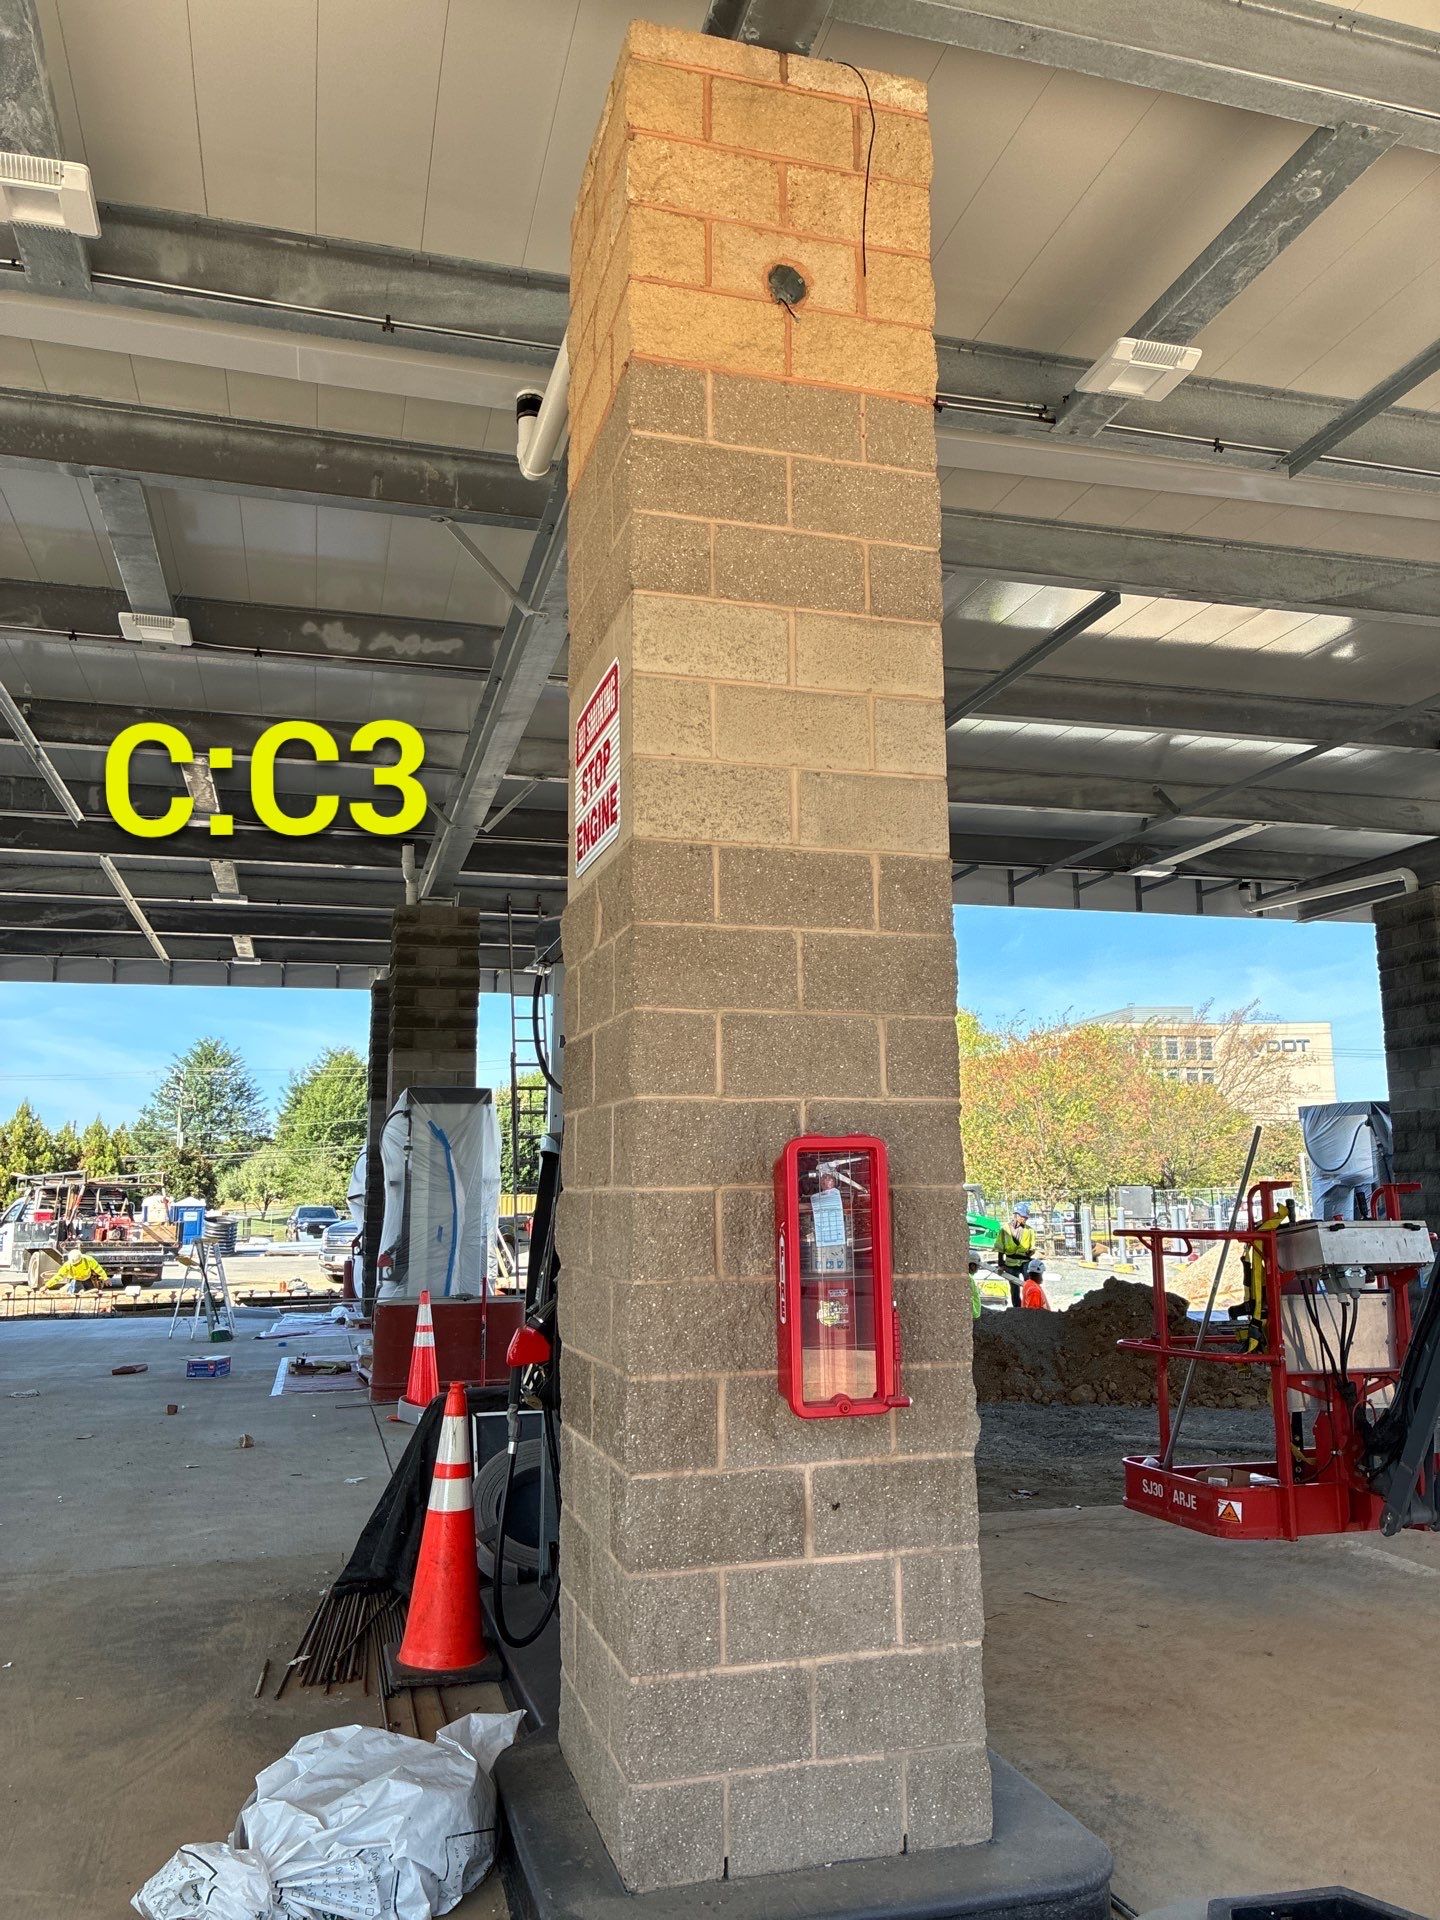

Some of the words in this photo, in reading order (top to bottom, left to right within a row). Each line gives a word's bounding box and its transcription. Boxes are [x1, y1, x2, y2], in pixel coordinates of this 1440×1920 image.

[582, 738, 611, 806] STOP
[577, 782, 618, 860] ENGINE
[1142, 1478, 1164, 1498] SJ30
[1172, 1489, 1198, 1511] ARJE
